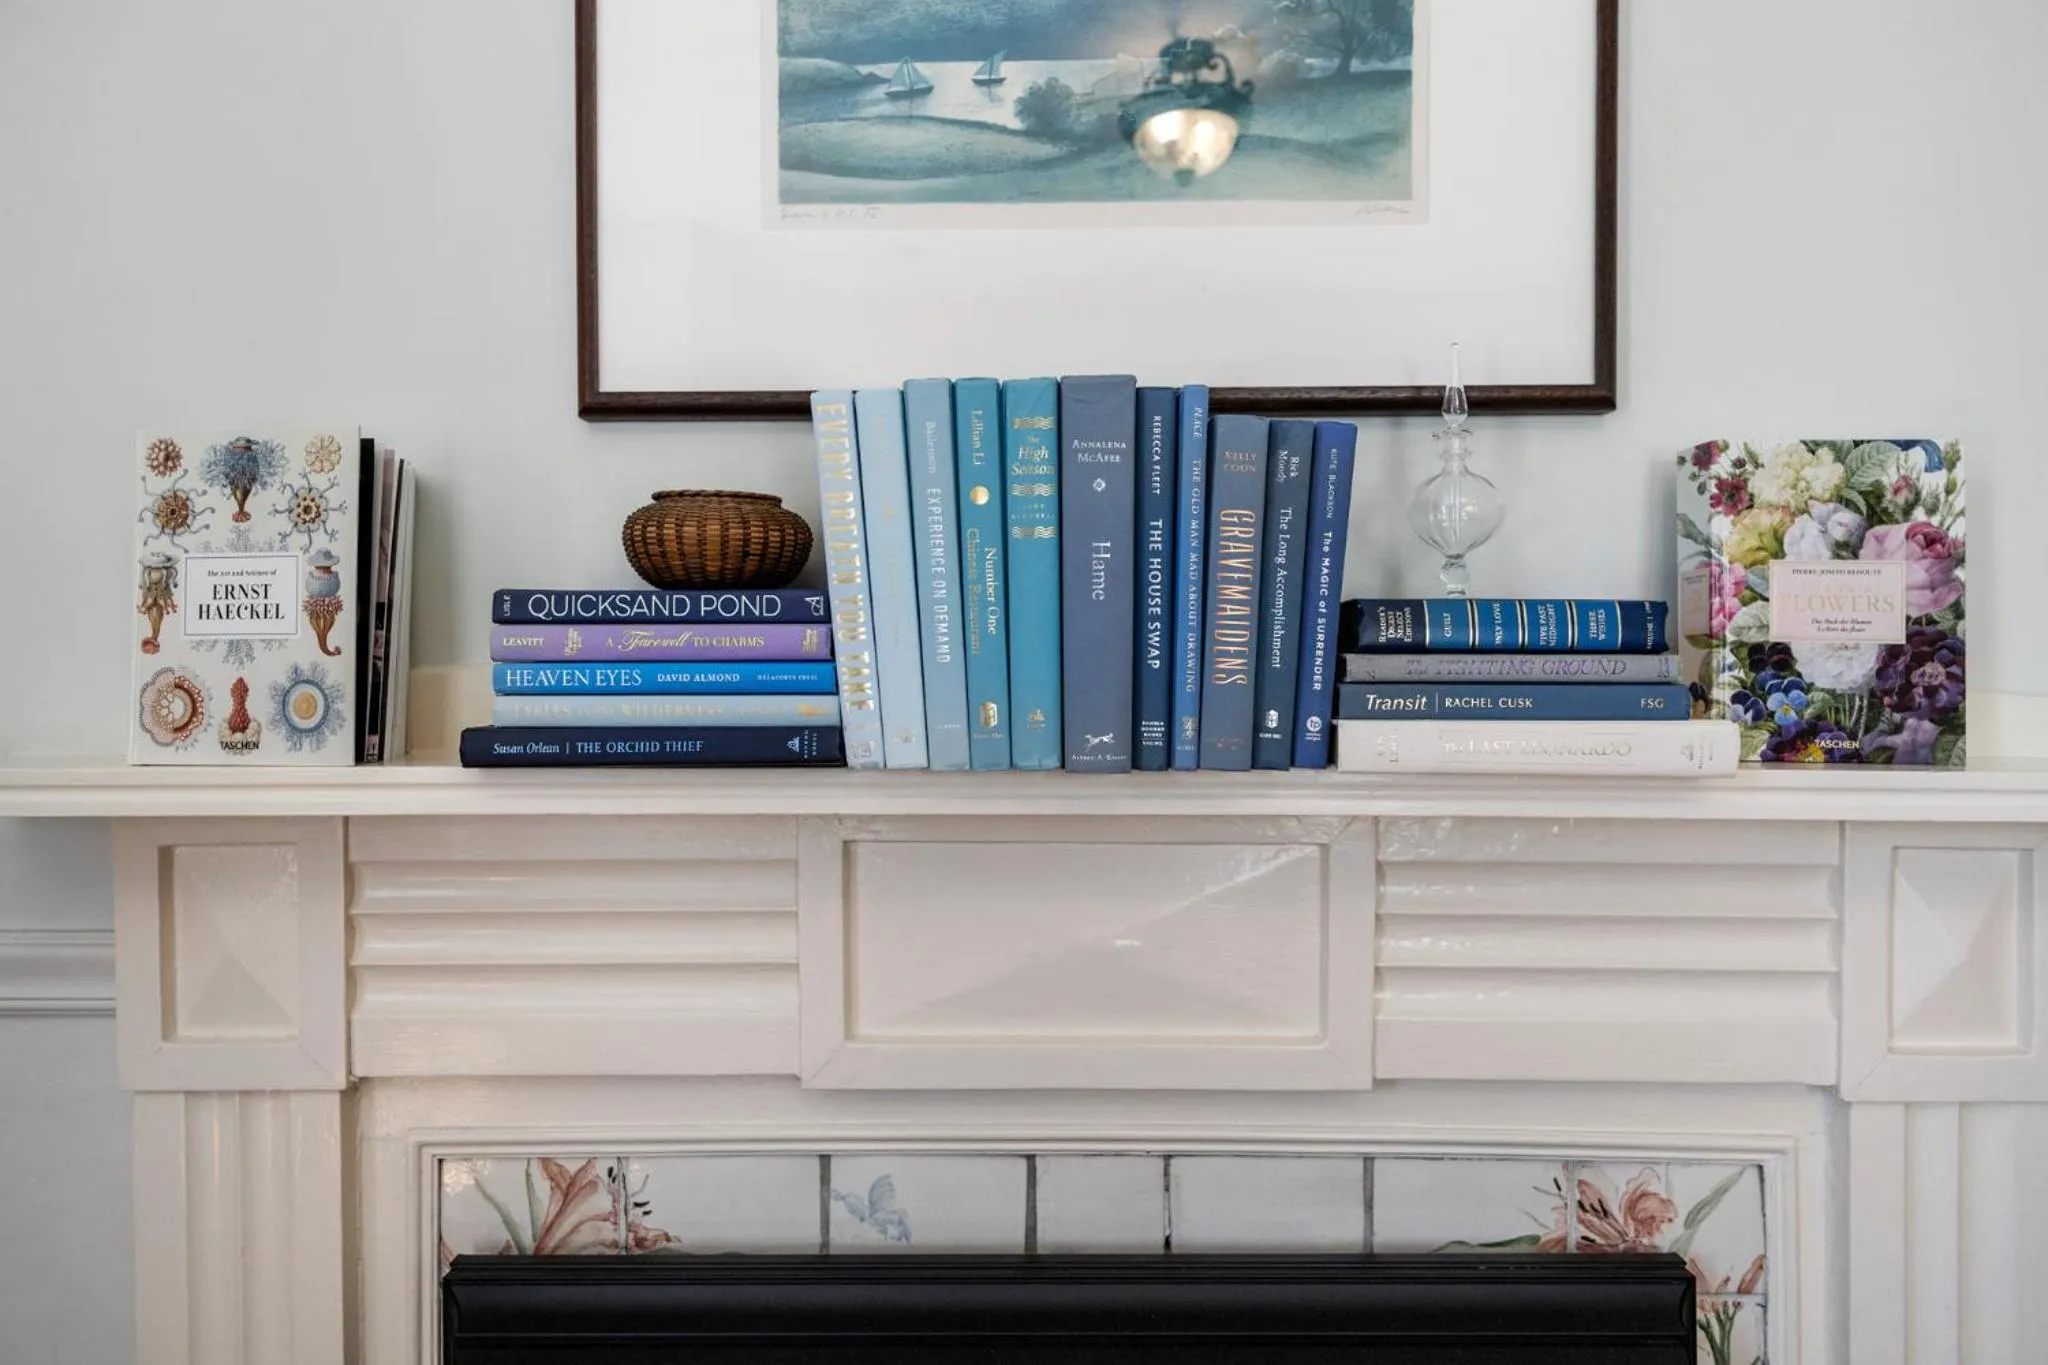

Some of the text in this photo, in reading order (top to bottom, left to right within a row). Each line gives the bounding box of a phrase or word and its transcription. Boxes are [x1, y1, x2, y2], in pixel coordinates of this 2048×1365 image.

[816, 403, 853, 480] EVERY
[923, 421, 936, 473] Bailenson
[970, 409, 985, 465] Lillian Li
[1018, 445, 1049, 461] High
[1151, 415, 1162, 495] REBECCA FLEET
[1277, 449, 1288, 482] Moody
[1011, 463, 1055, 476] Season
[1290, 456, 1300, 477] Rick
[826, 492, 862, 585] BREATH
[926, 488, 951, 663] EXPERIENCE ON DEMAND
[1092, 541, 1111, 600] Hame
[1186, 459, 1200, 692] THE OLD MAN MAD ABOUT DRAWING
[212, 583, 272, 600] ERNST
[966, 528, 983, 654] Chinese Restaurant
[985, 547, 1000, 634] Number One
[1147, 518, 1163, 669] THE HOUSE SWAP
[1211, 508, 1256, 686] GRAVEMAIDENS
[1271, 507, 1292, 668] The Long Accomplishment
[198, 603, 285, 620] HAECKEL
[527, 593, 782, 621] QUICKSAND POND
[1312, 531, 1332, 690] The MAGIC of SURRENDER
[1779, 593, 1895, 613] FLOWERS
[837, 594, 868, 642] YOU
[1443, 611, 1451, 637] GUILT
[502, 637, 544, 647] LEAVITT
[605, 631, 765, 651] A Farewell TO CHARMS
[506, 668, 643, 687] HEAVEN EYES
[657, 672, 741, 683] DAVID ALMOND
[1541, 659, 1627, 675] GROUND
[841, 651, 875, 713] TAKE
[1365, 693, 1428, 711] Transit
[1444, 696, 1534, 708] RACHEL CUSK
[1640, 697, 1664, 709] FSG
[220, 741, 260, 751] TASCHEN
[493, 741, 560, 754] Susan Orlean
[576, 740, 704, 754] THE ORCHID THIEF
[1814, 739, 1859, 749] TASCHEN
